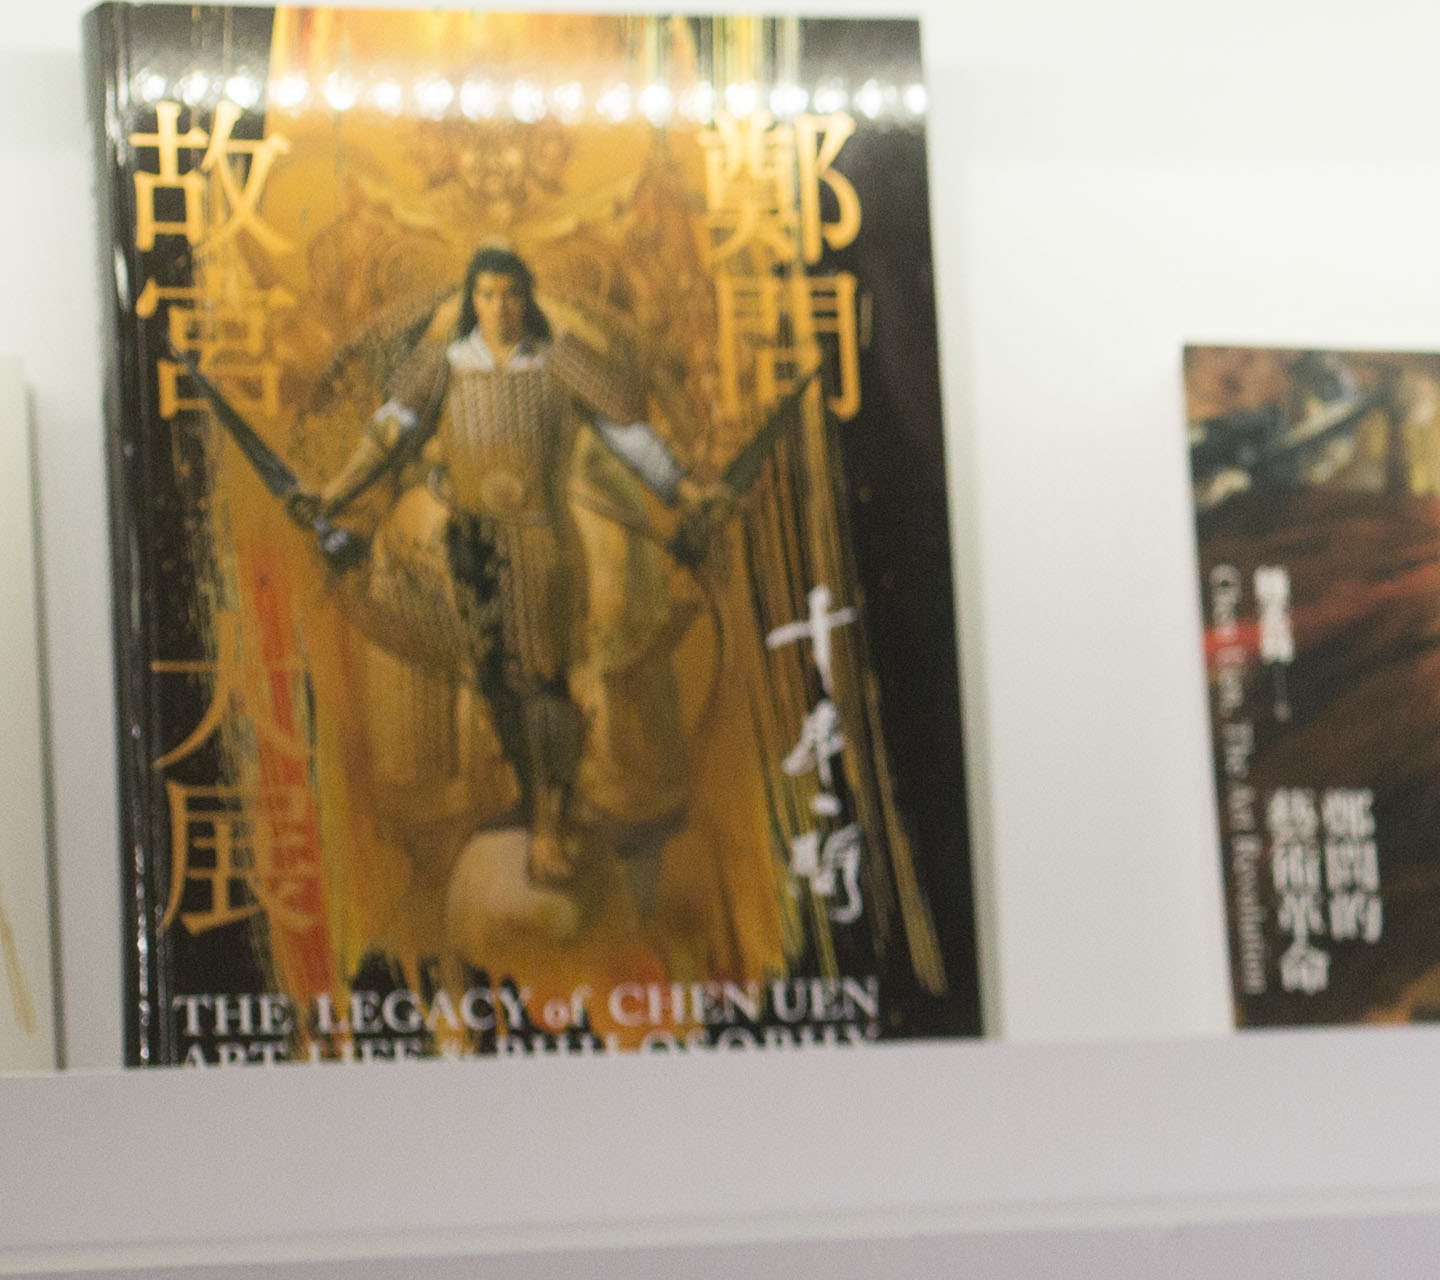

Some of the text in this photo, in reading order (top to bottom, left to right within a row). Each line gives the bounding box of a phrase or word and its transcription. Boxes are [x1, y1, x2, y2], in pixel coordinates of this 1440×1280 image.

[699, 110, 863, 423] 鄭問
[129, 99, 318, 936] 故宮 大展
[172, 976, 881, 1037] THE LEGACY of CHEN UEN
